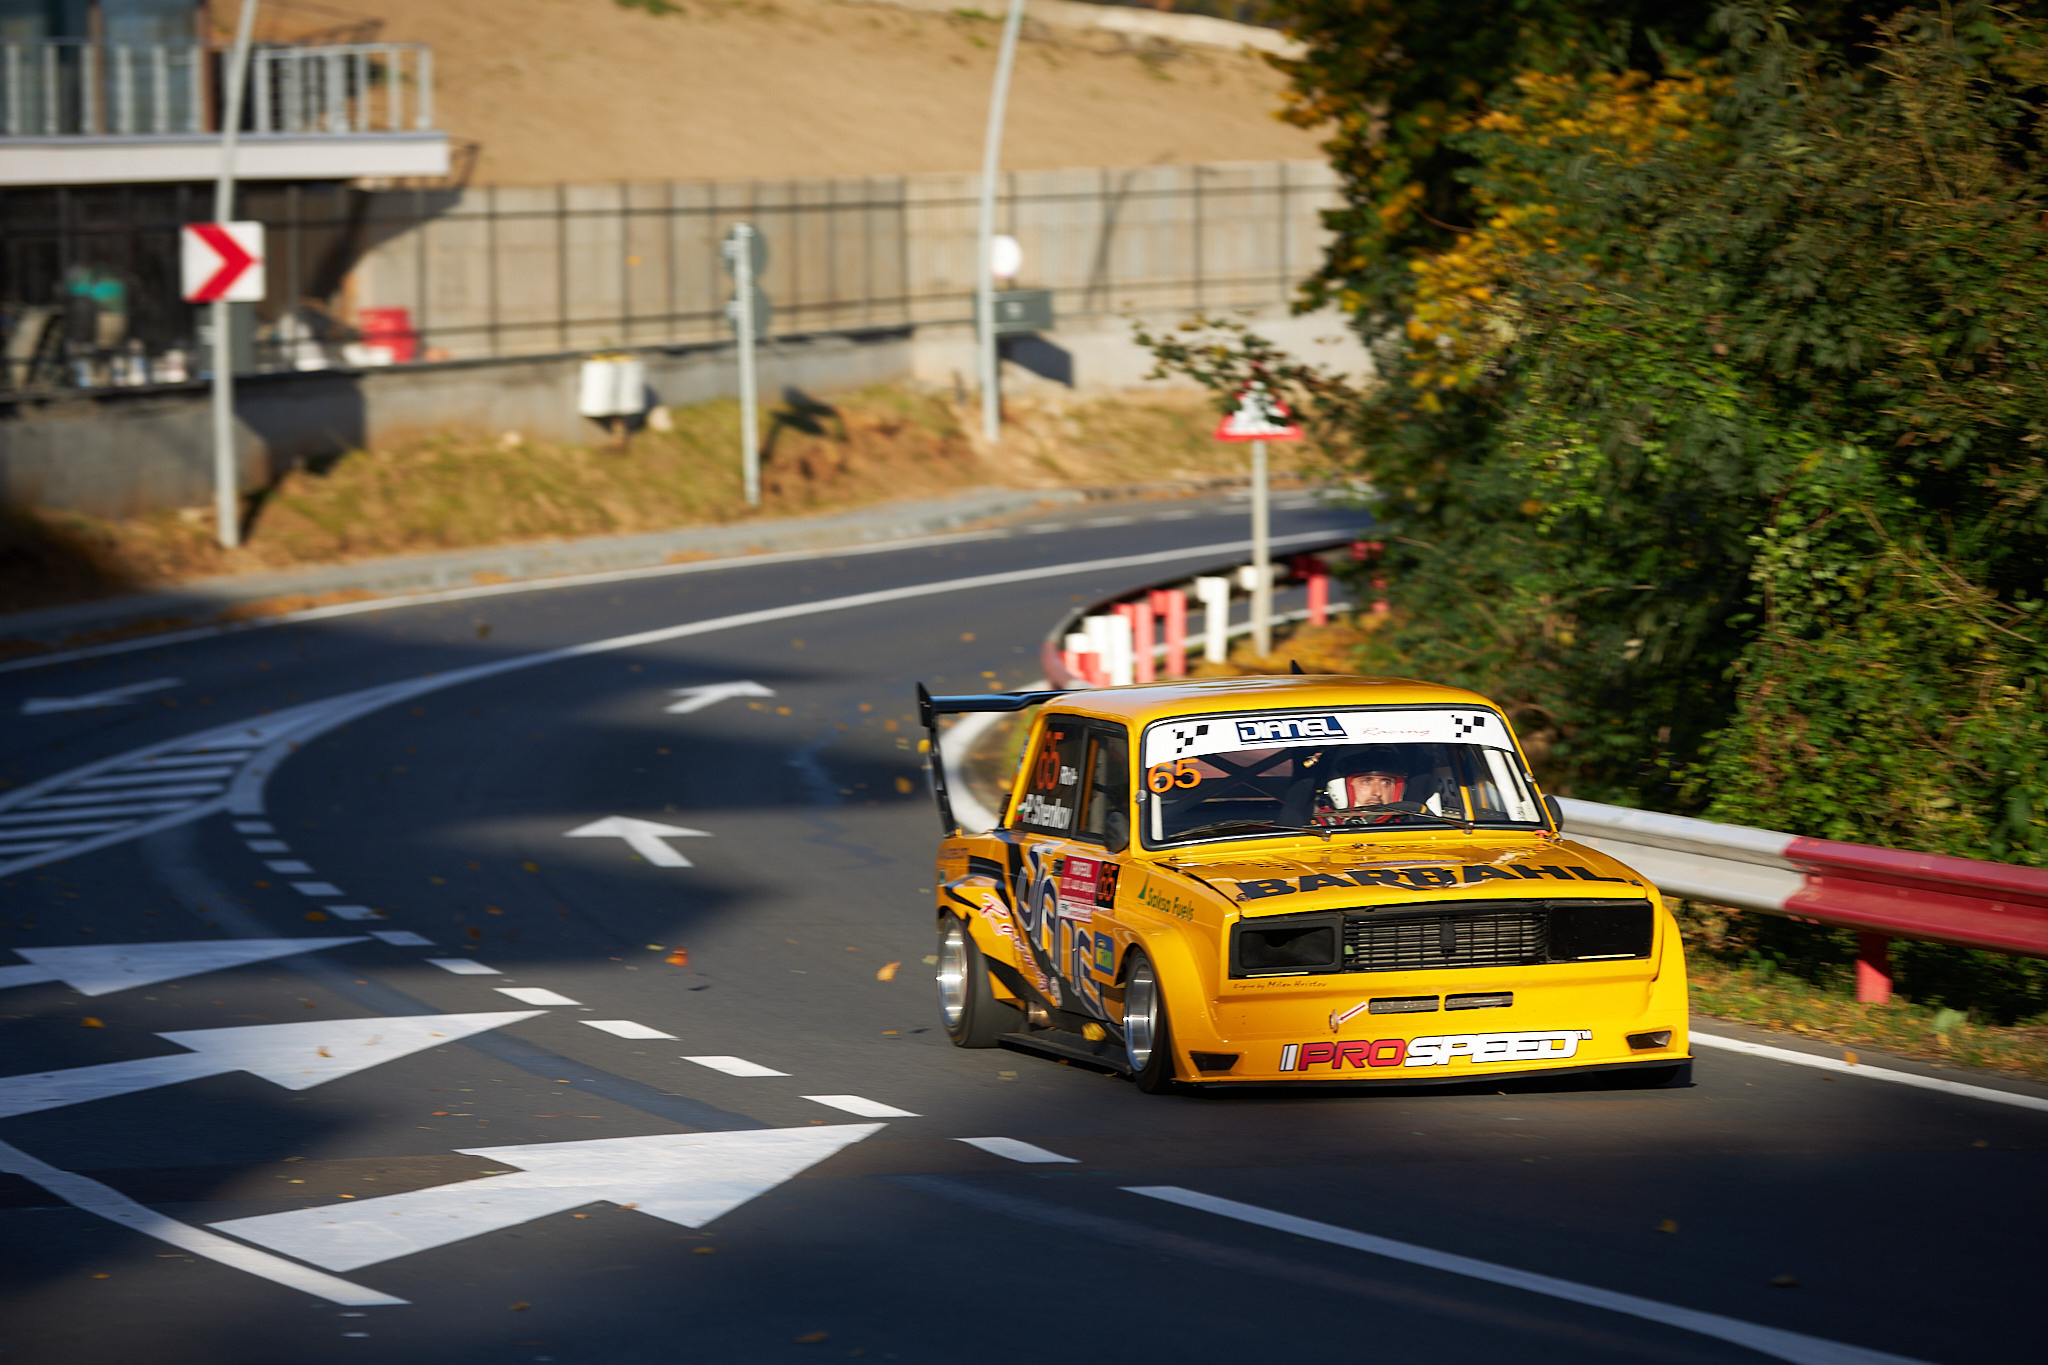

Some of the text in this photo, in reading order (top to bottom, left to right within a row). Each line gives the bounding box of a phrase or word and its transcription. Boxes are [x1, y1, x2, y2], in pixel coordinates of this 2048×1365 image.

[1037, 731, 1064, 790] 65
[1148, 759, 1201, 793] 65
[1097, 863, 1118, 901] 65
